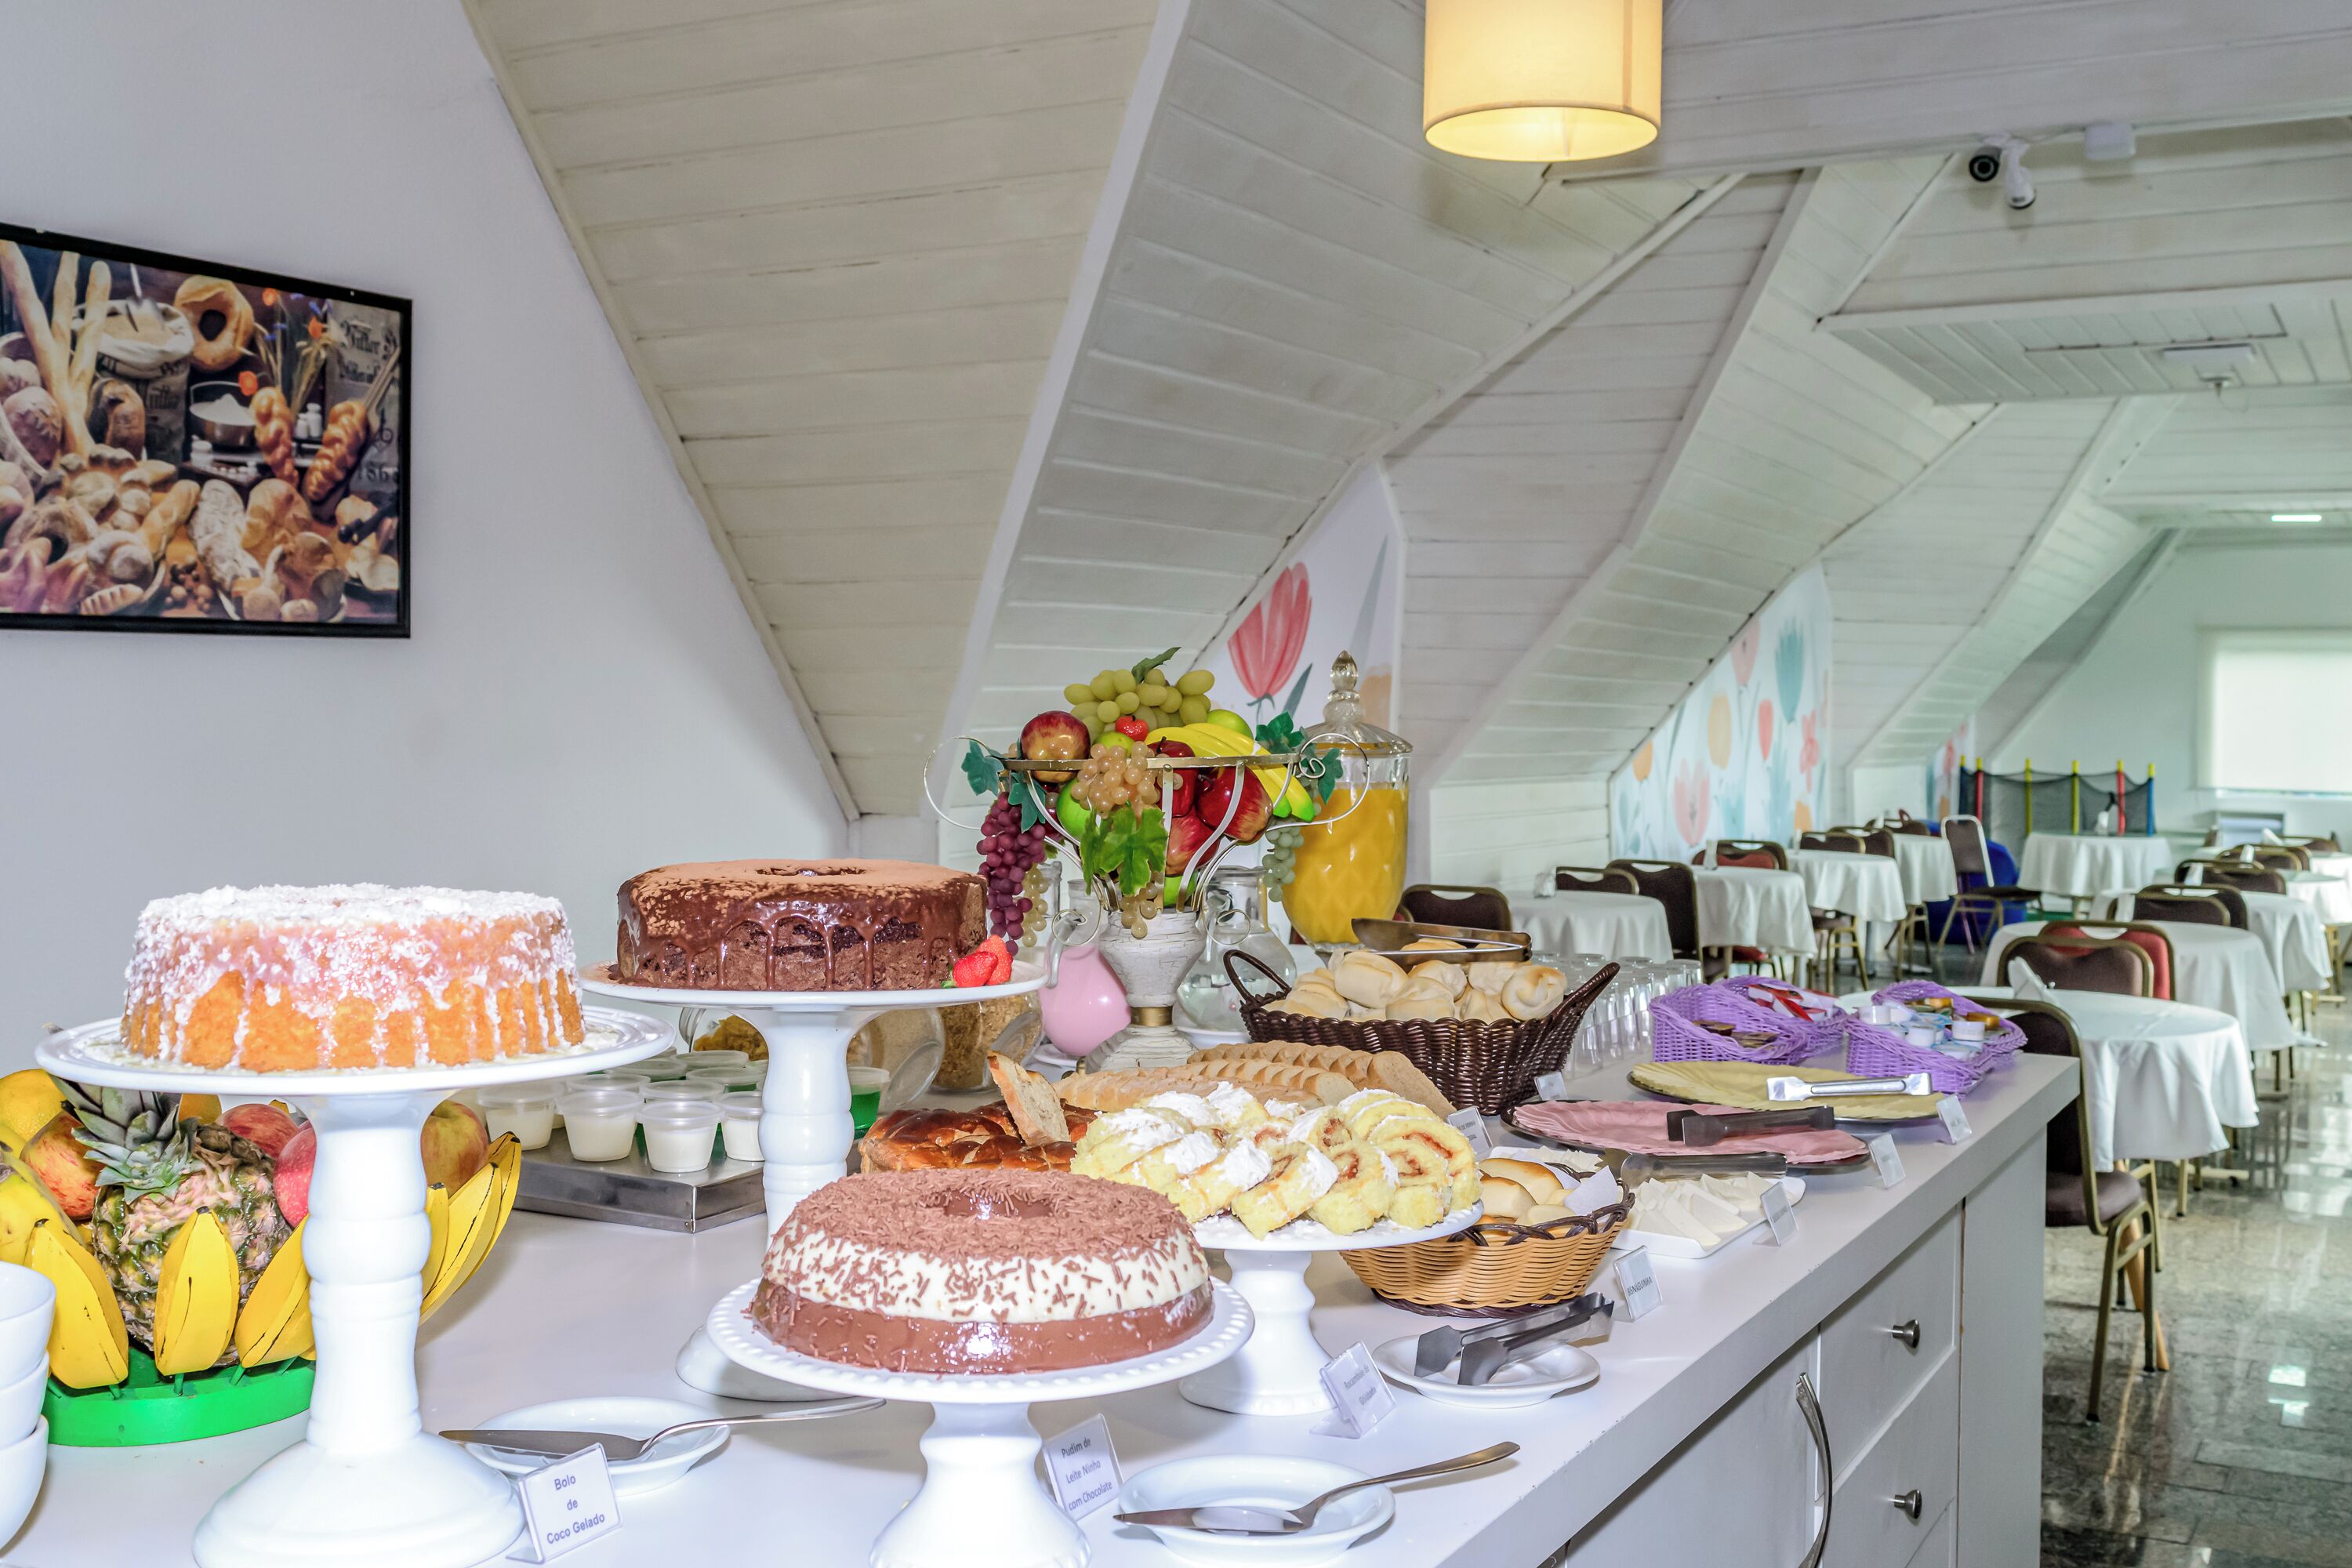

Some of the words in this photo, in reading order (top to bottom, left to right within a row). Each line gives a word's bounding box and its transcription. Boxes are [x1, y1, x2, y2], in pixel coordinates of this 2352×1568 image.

[1062, 1443, 1083, 1458] Pudim
[1083, 1437, 1091, 1448] de
[554, 1475, 576, 1490] Bolo
[1065, 1470, 1082, 1483] Leite
[1082, 1461, 1101, 1475] Ninho
[567, 1498, 578, 1511] de
[1069, 1498, 1083, 1511] com
[1082, 1482, 1112, 1503] Chocolate
[546, 1528, 571, 1544] Coco
[572, 1513, 605, 1534] Gelado
